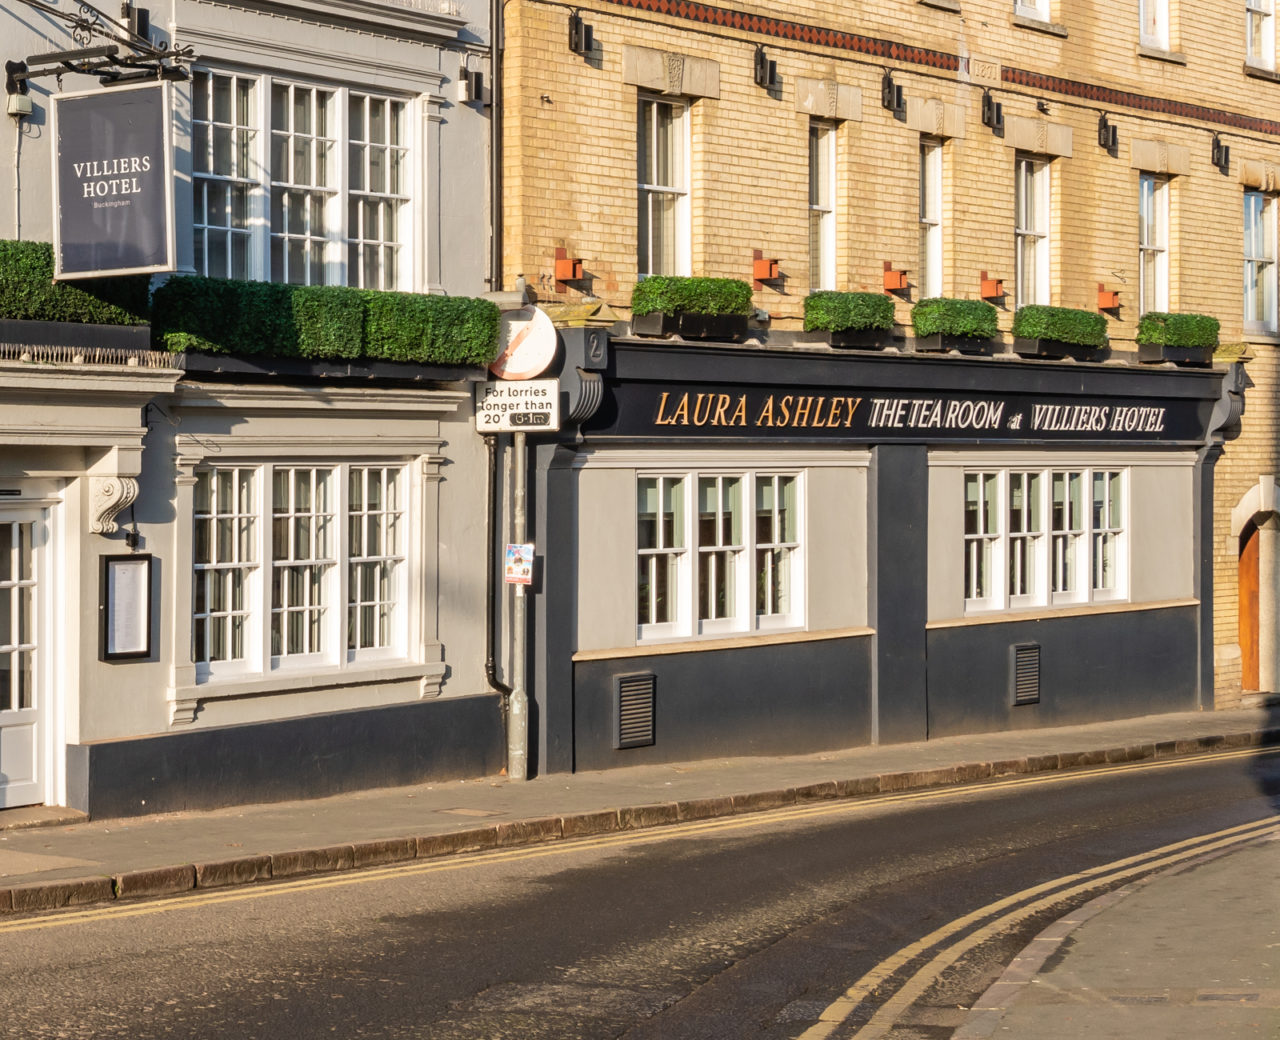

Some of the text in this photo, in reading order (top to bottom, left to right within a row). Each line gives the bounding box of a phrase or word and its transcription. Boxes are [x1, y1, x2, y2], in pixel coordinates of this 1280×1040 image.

[73, 156, 151, 178] VILLIERS
[83, 178, 141, 198] HOTEL
[93, 200, 131, 209] Buckingham
[485, 387, 547, 397] For lorries
[481, 400, 552, 412] longer than
[654, 391, 748, 427] LAURA
[754, 394, 863, 428] ASHLEY
[869, 398, 909, 428] THE
[1032, 404, 1109, 432] VILLIERS
[1110, 407, 1166, 432] HOTEL
